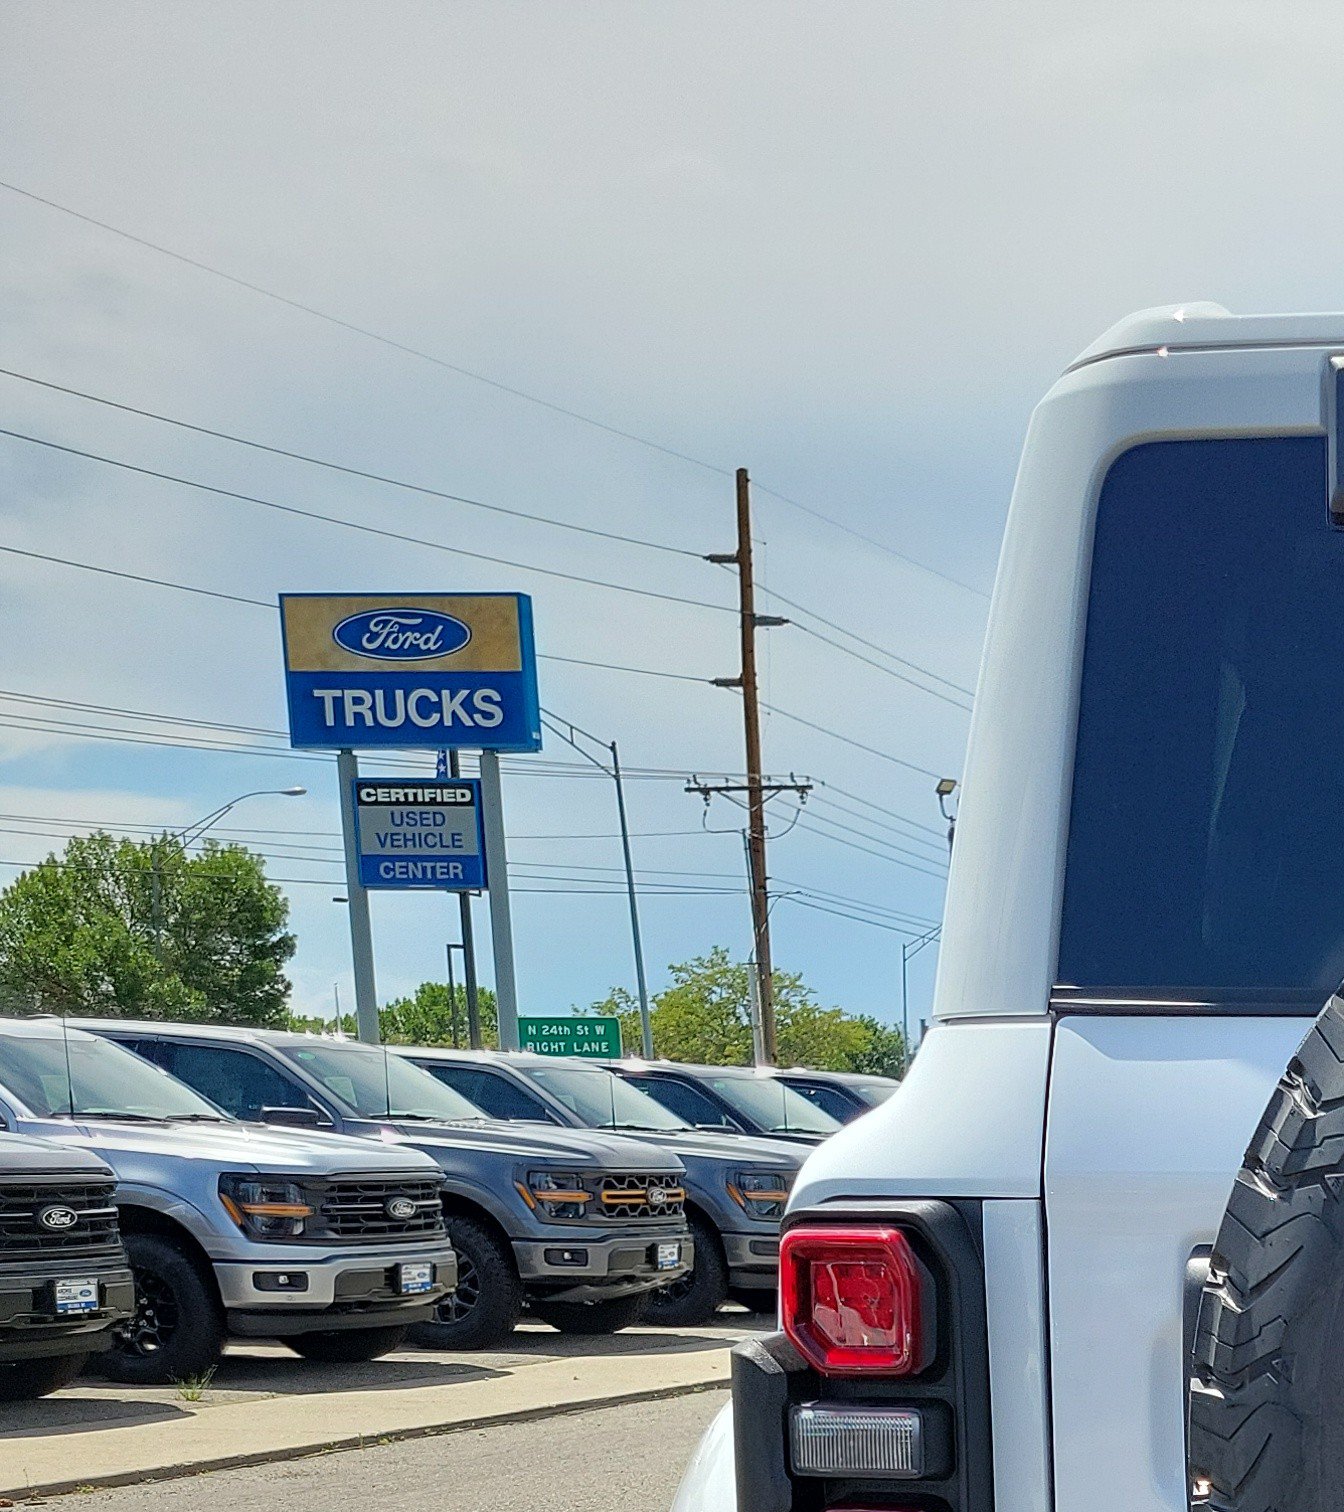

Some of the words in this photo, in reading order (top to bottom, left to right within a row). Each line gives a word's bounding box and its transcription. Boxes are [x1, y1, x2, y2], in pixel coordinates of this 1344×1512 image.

[361, 615, 443, 651] Ford
[312, 688, 504, 728] TRUCKS
[359, 787, 472, 803] CERTIFIED
[390, 810, 446, 828] USED
[375, 831, 464, 850] VEHICLE
[379, 861, 464, 880] CENTER
[527, 1024, 537, 1036] N
[541, 1024, 571, 1036] 24th
[576, 1024, 589, 1036] St
[595, 1024, 605, 1036] W
[526, 1041, 566, 1053] RIGHT
[573, 1041, 610, 1053] LANE
